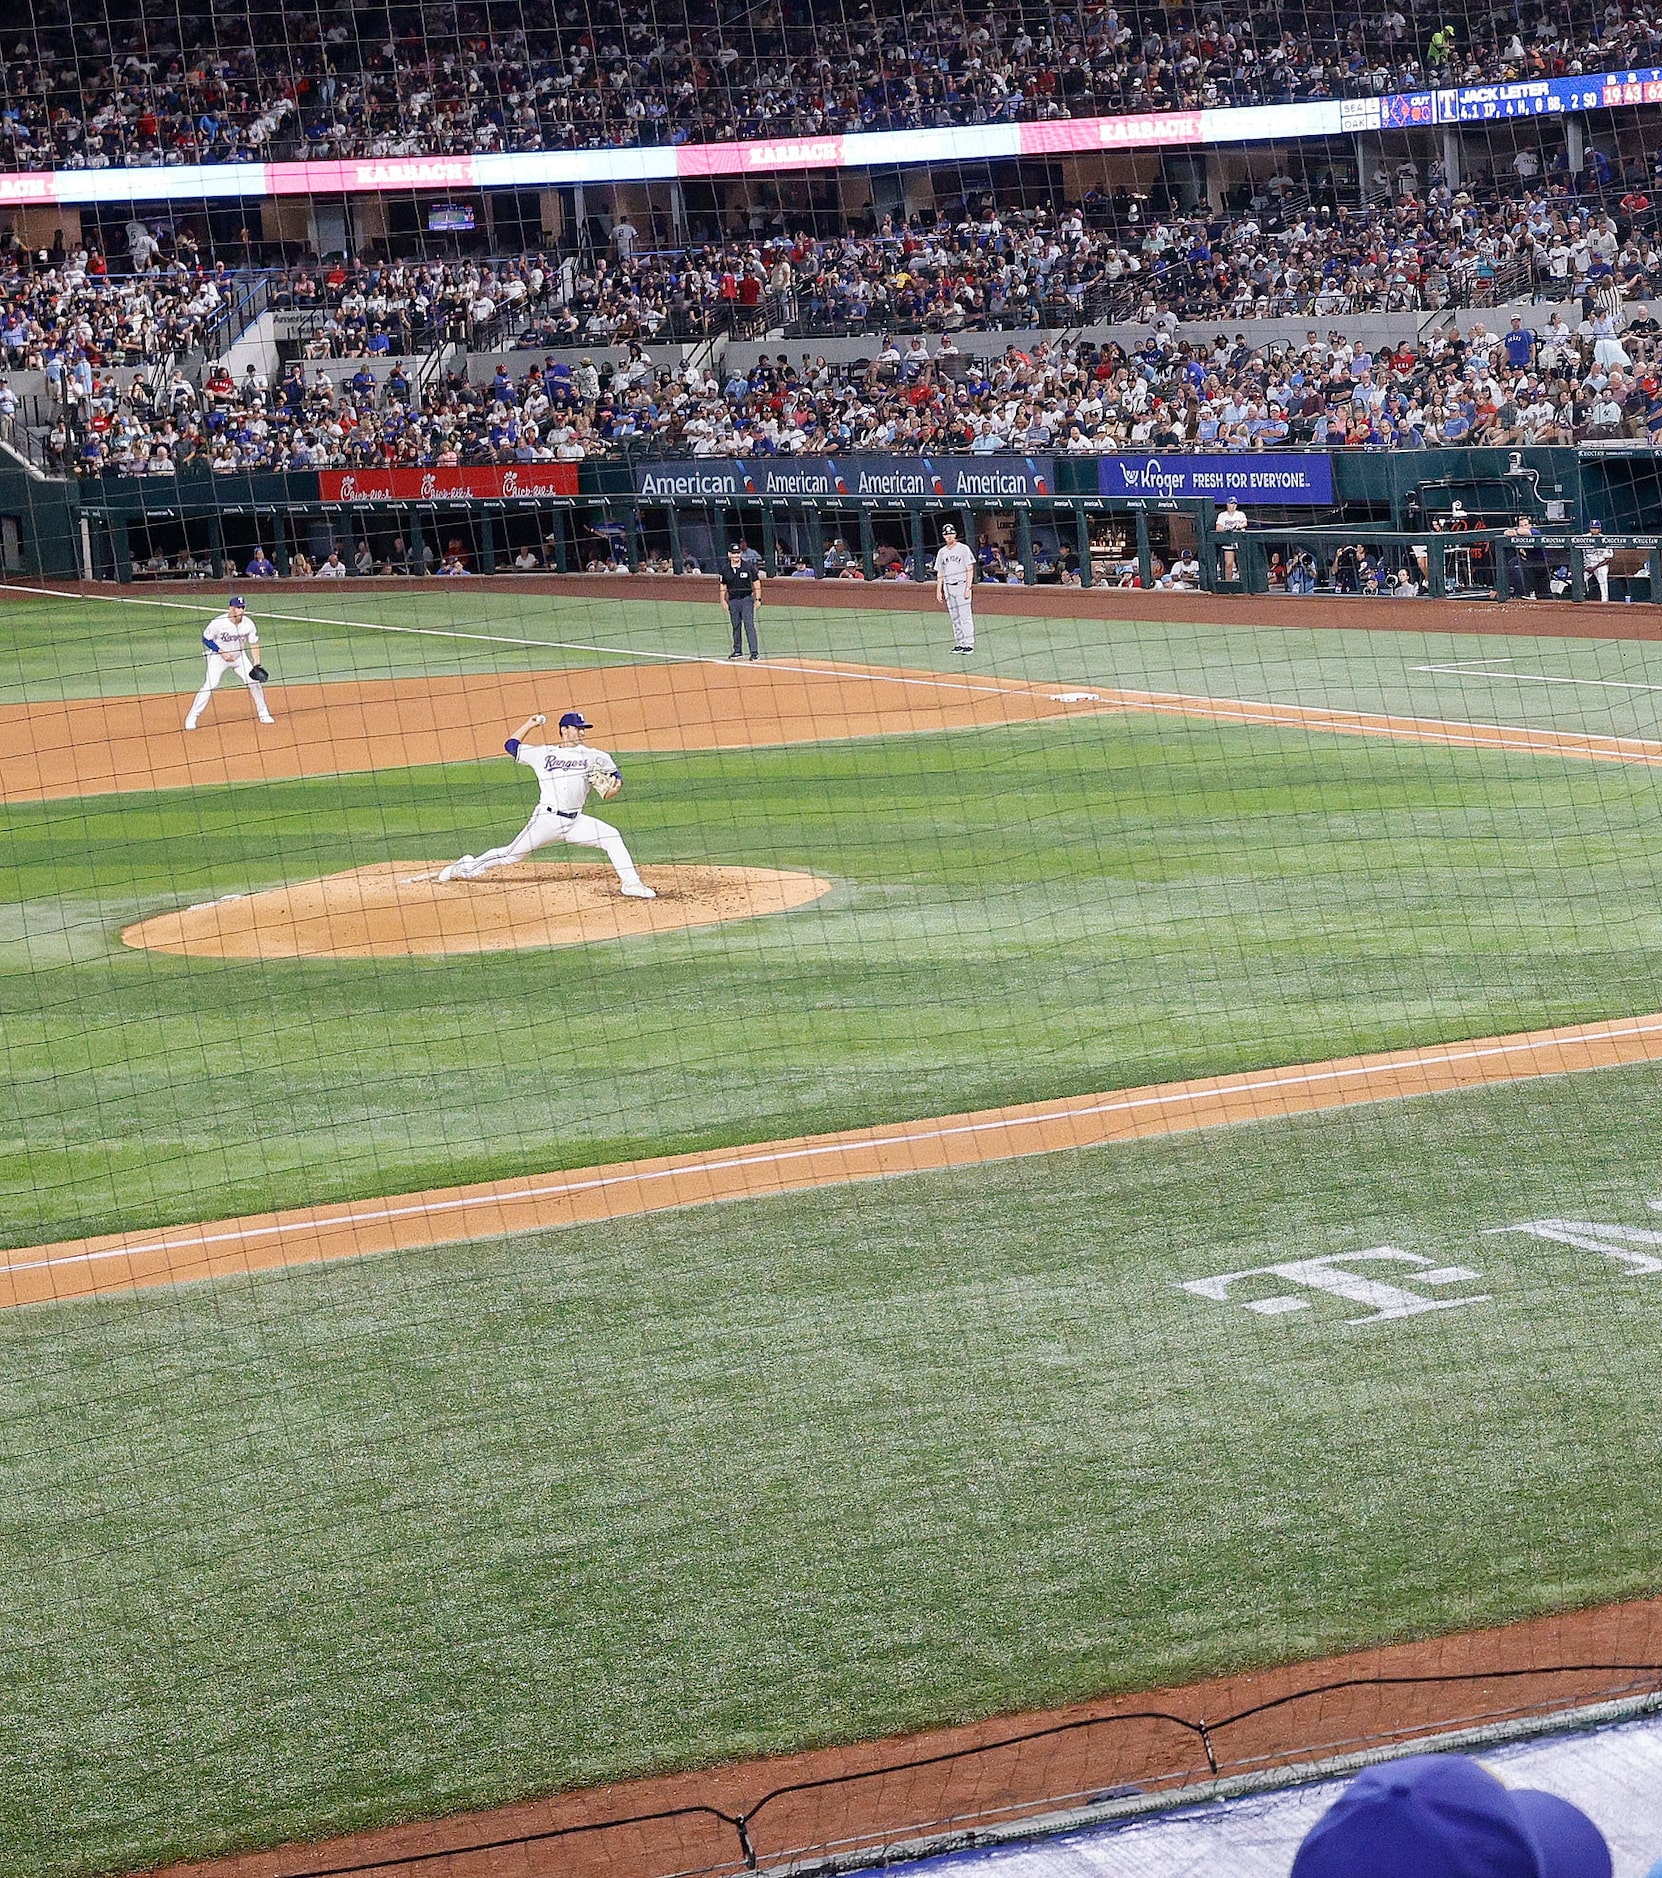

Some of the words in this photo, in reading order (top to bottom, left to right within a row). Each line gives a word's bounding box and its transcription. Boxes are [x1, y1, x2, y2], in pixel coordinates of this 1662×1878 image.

[1607, 75, 1616, 86] B
[1628, 73, 1637, 83] S
[1651, 71, 1661, 81] T
[1410, 96, 1430, 106] OUT
[1459, 87, 1500, 104] JACK
[1500, 82, 1549, 101] LEITER
[1605, 88, 1622, 104] 19
[1624, 86, 1642, 102] 43
[1344, 103, 1363, 113] SEA
[1382, 105, 1389, 119] 8
[1440, 91, 1457, 120] T
[1460, 104, 1479, 119] 4.1
[1484, 104, 1500, 119] IP,
[1506, 101, 1514, 115] 4
[1518, 101, 1530, 116] H,
[1547, 97, 1565, 113] BB,
[1571, 94, 1579, 108] 2
[1583, 92, 1597, 107] SO
[1100, 118, 1194, 141] KARBACH
[1345, 117, 1365, 129] OAK
[749, 144, 837, 165] KARBACH
[356, 161, 462, 184] KARBACH
[642, 472, 736, 495] American
[766, 471, 829, 493] American
[858, 470, 924, 494] American
[957, 470, 1027, 494] American
[1141, 459, 1186, 497] Kroger
[1193, 473, 1224, 488] FRESH
[1227, 472, 1248, 488] FOR
[544, 754, 589, 772] Rangers
[1172, 1245, 1496, 1326] T
